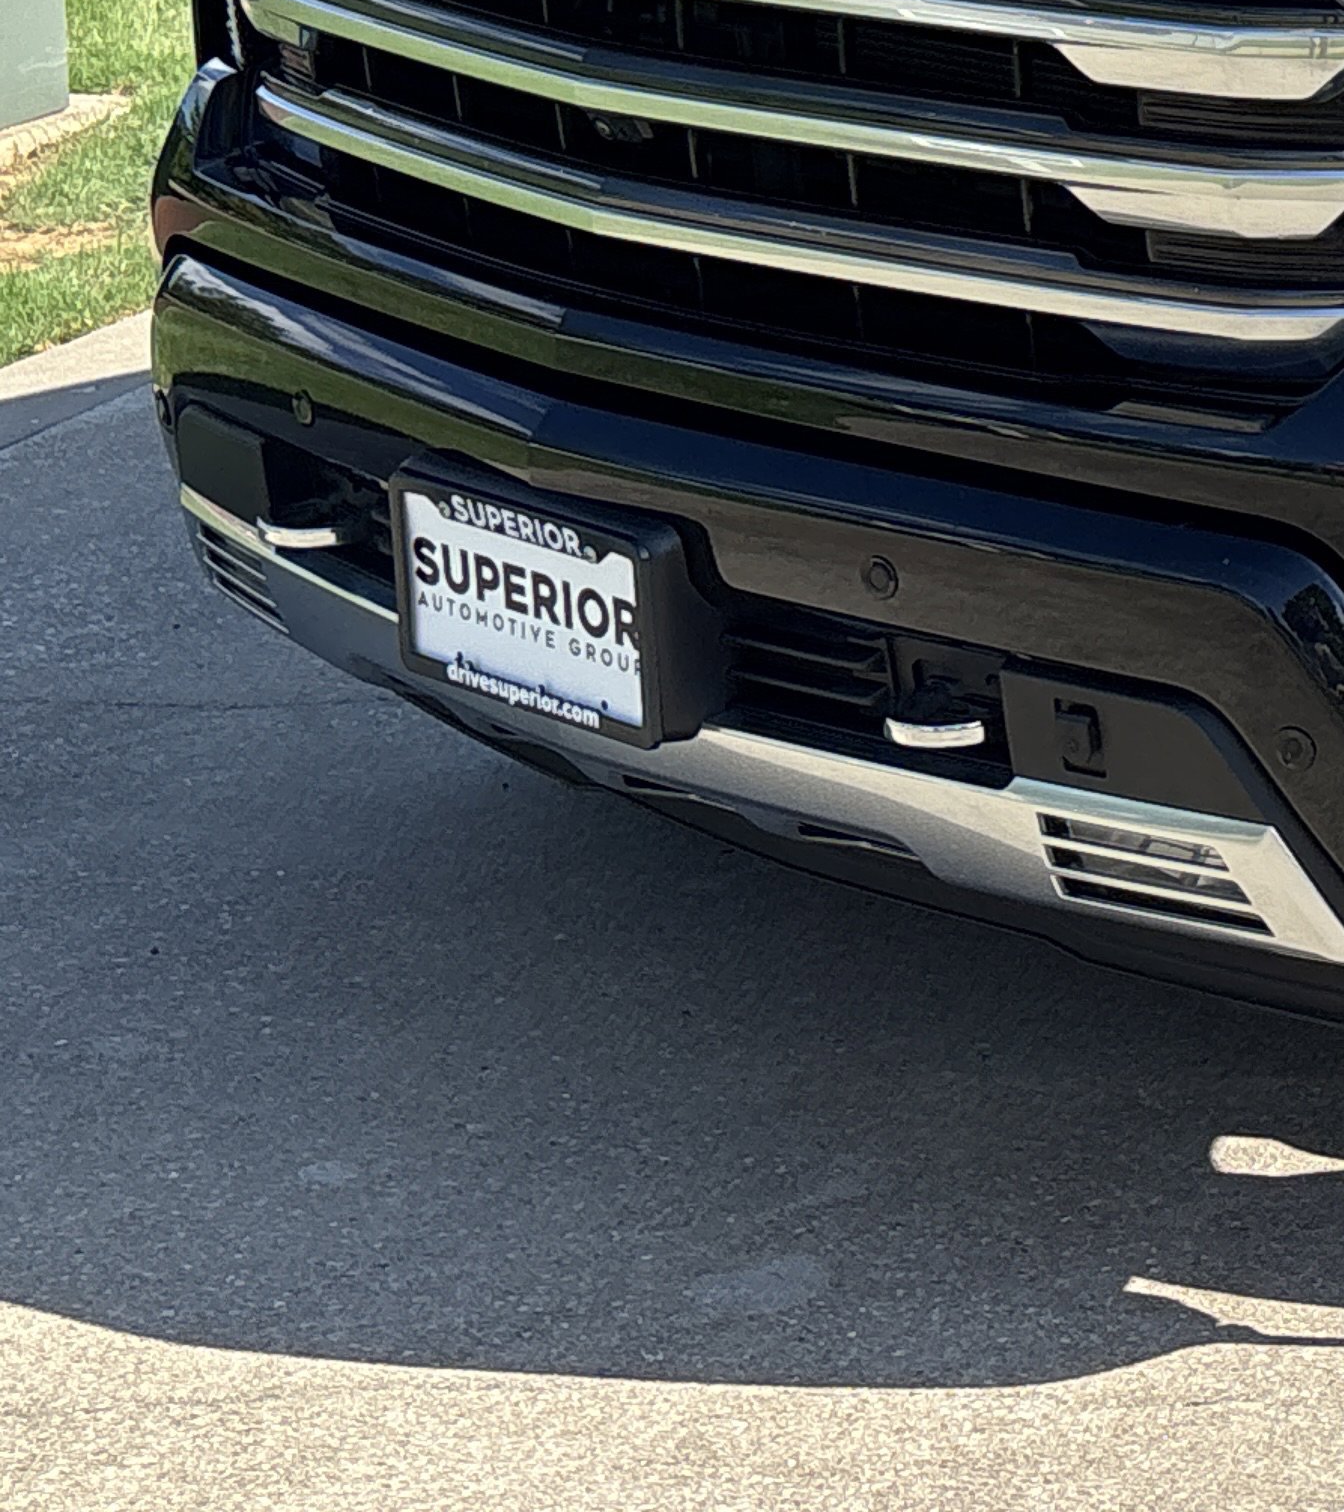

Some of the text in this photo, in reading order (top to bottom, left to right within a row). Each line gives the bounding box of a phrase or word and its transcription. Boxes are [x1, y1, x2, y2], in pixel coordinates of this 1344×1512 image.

[450, 494, 583, 557] SUPERIOR
[413, 536, 640, 652] SUPERIOR
[417, 590, 556, 650] AUTOMOTIVE
[446, 662, 600, 729] drivesuperior.com
